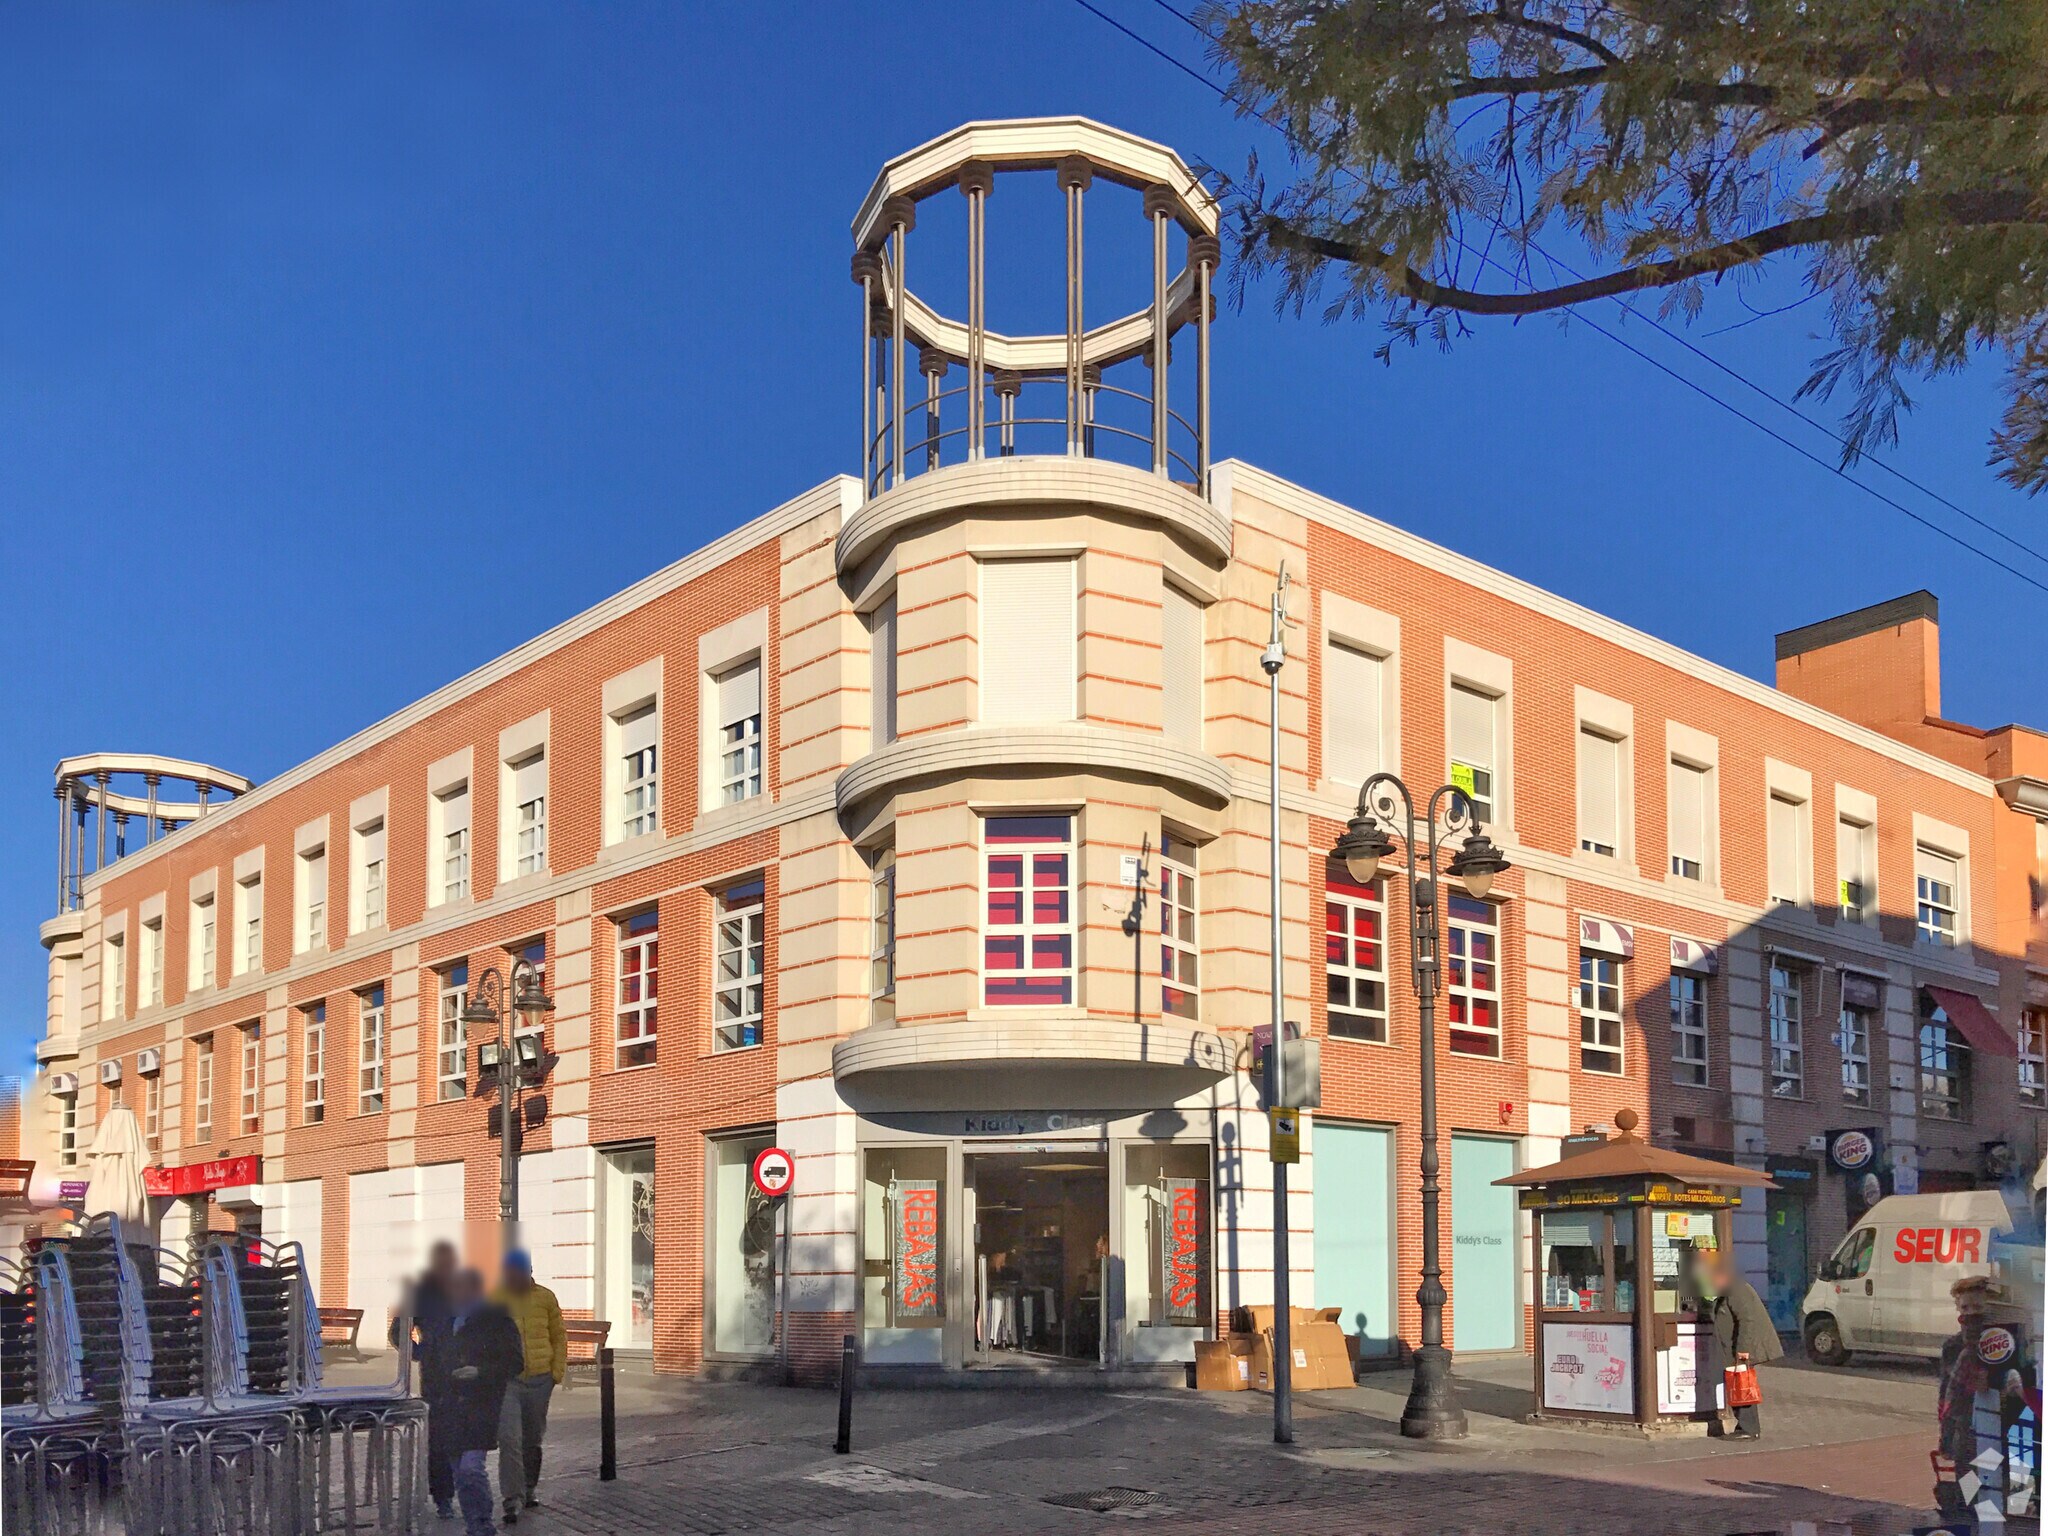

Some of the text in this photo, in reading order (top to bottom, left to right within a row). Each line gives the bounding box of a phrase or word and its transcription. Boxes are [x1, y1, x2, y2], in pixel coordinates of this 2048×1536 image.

[1838, 1138, 1865, 1152] BURGER
[1840, 1144, 1867, 1158] KING
[1571, 1191, 1619, 1204] MILLONES
[1456, 1235, 1502, 1246] Kiddy's Class
[1893, 1227, 1982, 1264] SEUR
[904, 1189, 937, 1308] REBAJAS
[1170, 1188, 1204, 1308] REBAJAS
[1583, 1328, 1609, 1343] HUELLA
[1980, 1333, 2008, 1348] BURGER
[1587, 1343, 1609, 1355] SOCIAL
[1981, 1339, 2010, 1355] KING
[1557, 1355, 1576, 1364] EURO
[1550, 1363, 1584, 1374] JACKPOT
